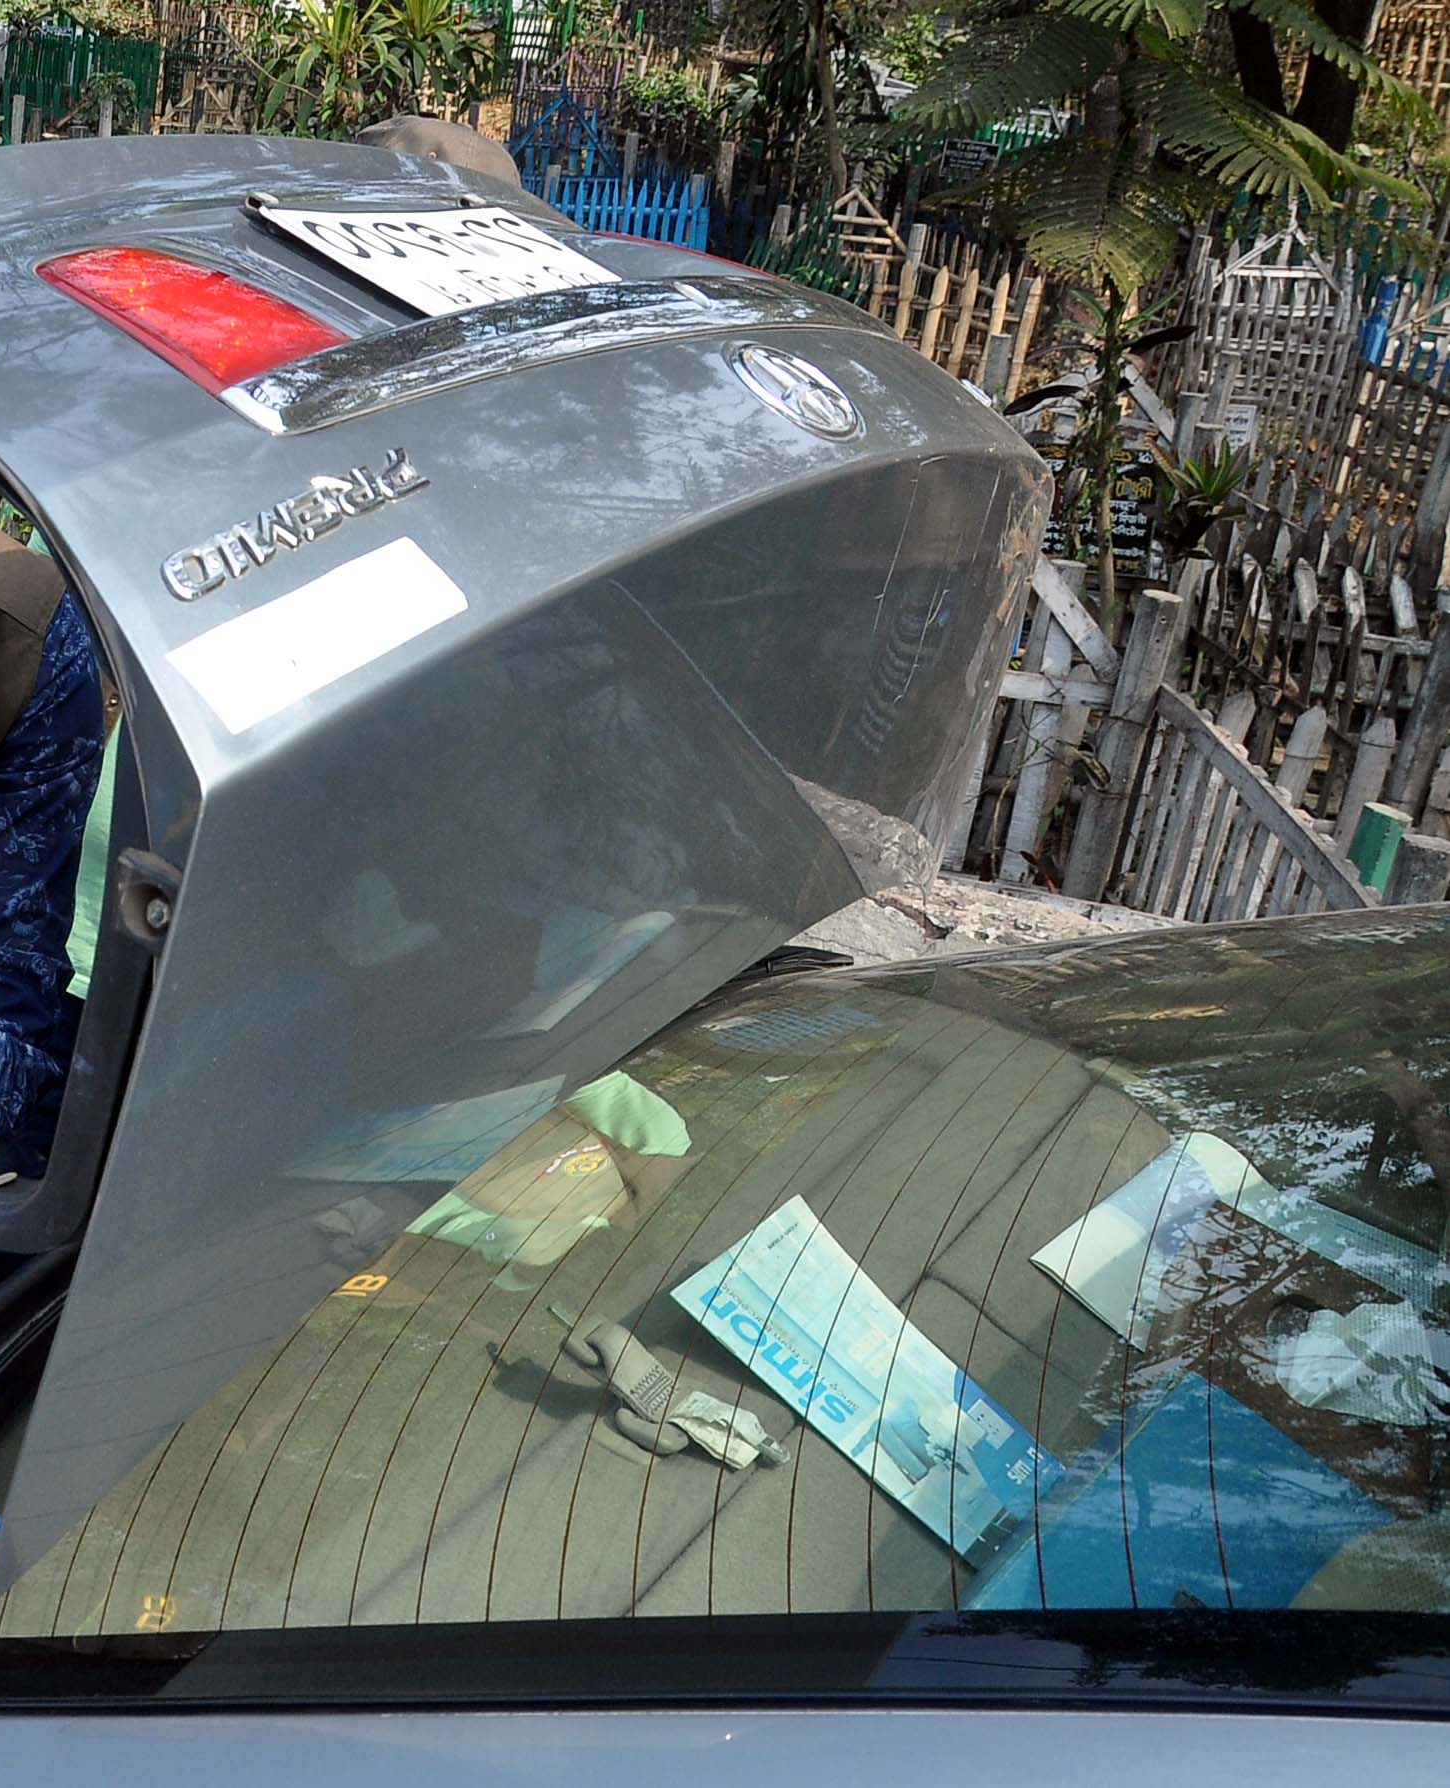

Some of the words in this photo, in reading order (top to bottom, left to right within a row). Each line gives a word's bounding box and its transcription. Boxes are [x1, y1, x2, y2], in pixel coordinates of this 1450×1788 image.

[160, 448, 431, 602] PREMIO
[699, 1286, 855, 1425] simon
[1006, 1446, 1044, 1485] simn
